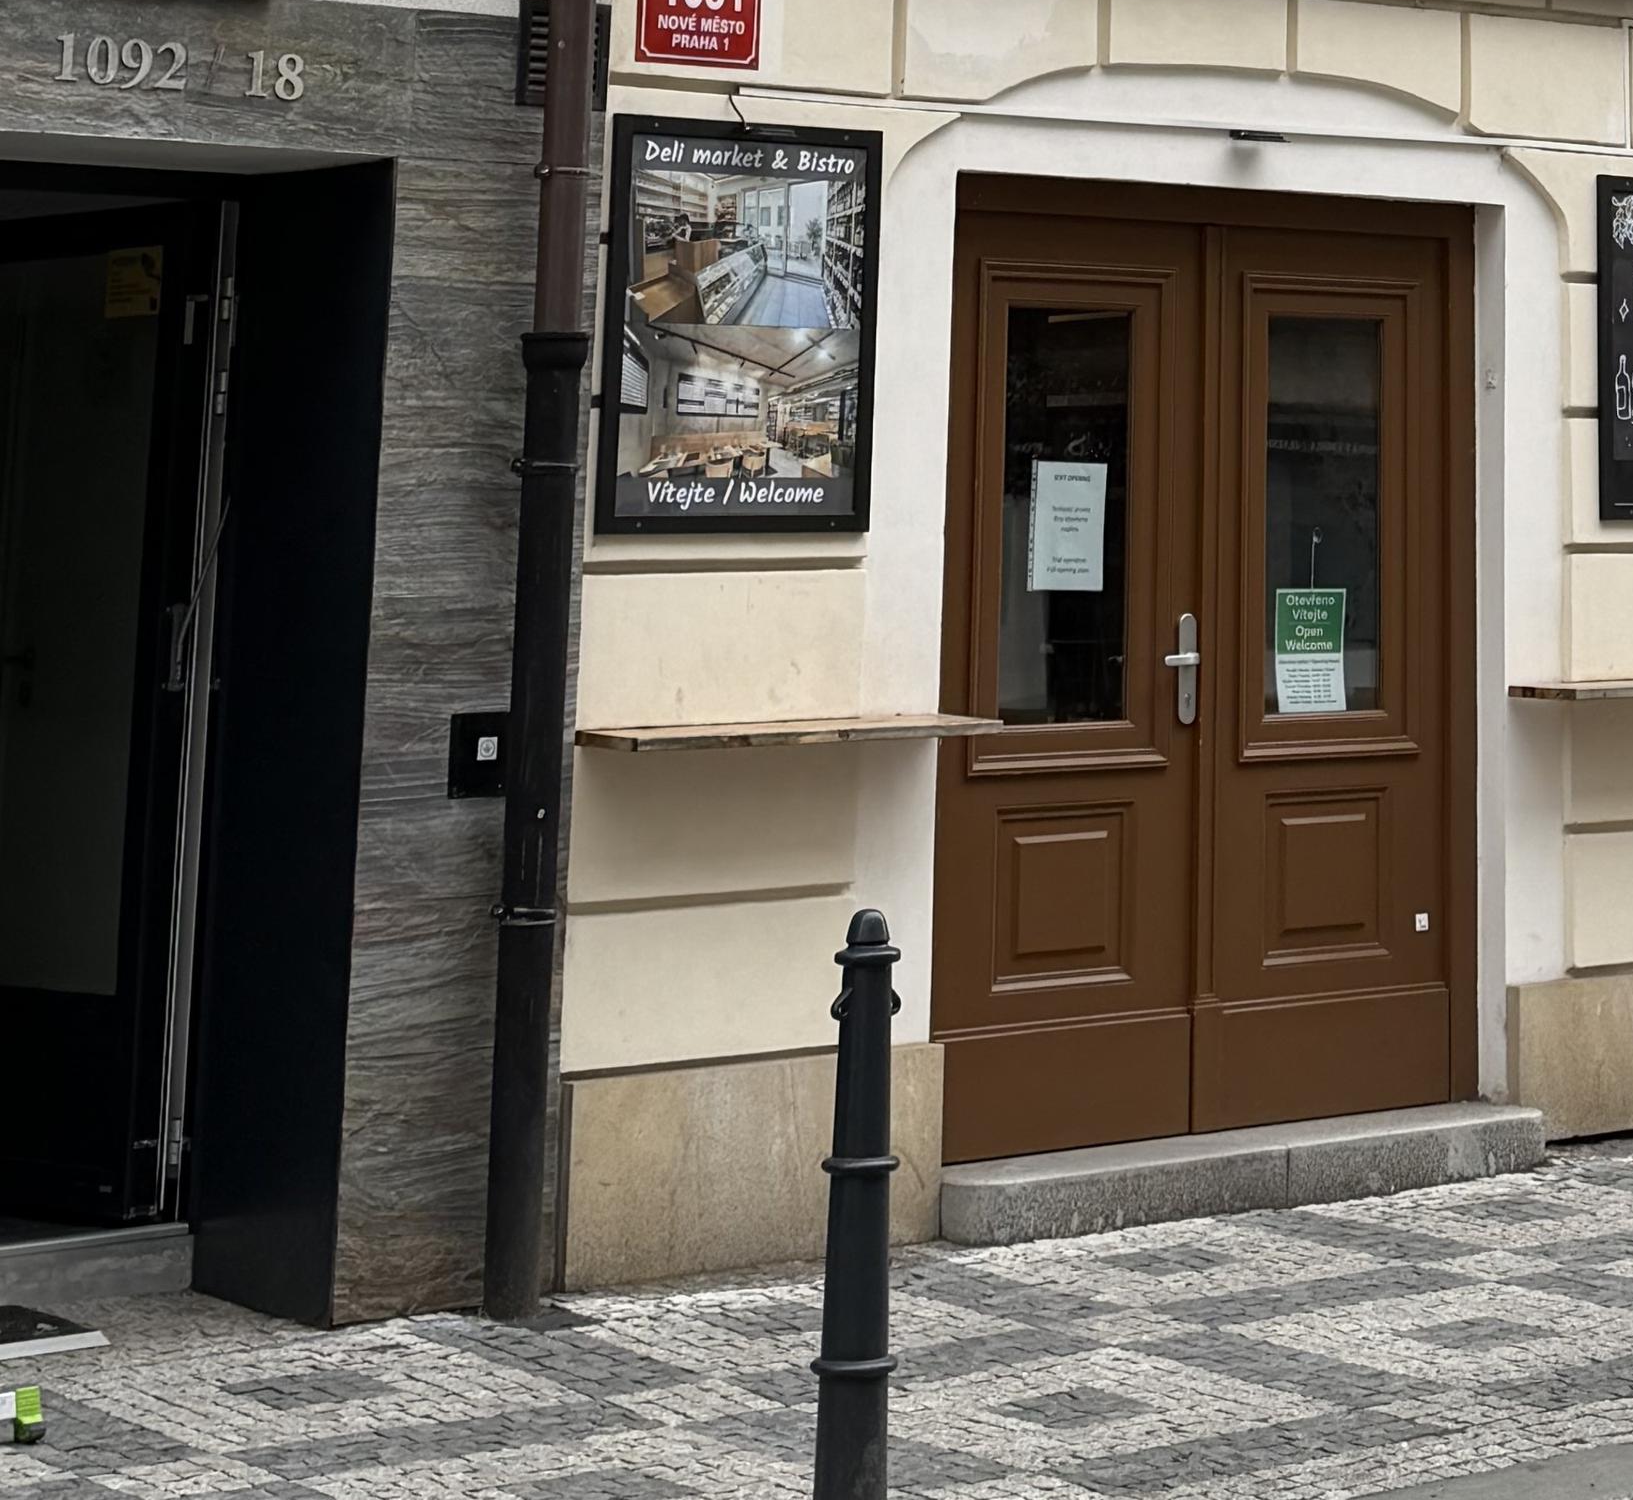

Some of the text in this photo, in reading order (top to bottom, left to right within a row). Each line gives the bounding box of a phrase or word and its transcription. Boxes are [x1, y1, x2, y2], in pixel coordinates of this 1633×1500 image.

[657, 14, 745, 34] NOVÉ MĚSTO
[672, 34, 730, 51] PRAHA 1
[54, 33, 188, 90] 1092
[243, 50, 305, 100] 18
[645, 140, 855, 174] Deli market & Bistro
[647, 479, 824, 511] Vítejte / Welcome
[1286, 594, 1335, 606] Otevřeno
[1292, 609, 1328, 622] Vítejte
[1295, 625, 1323, 639] Open
[1285, 639, 1333, 651] Welcome
